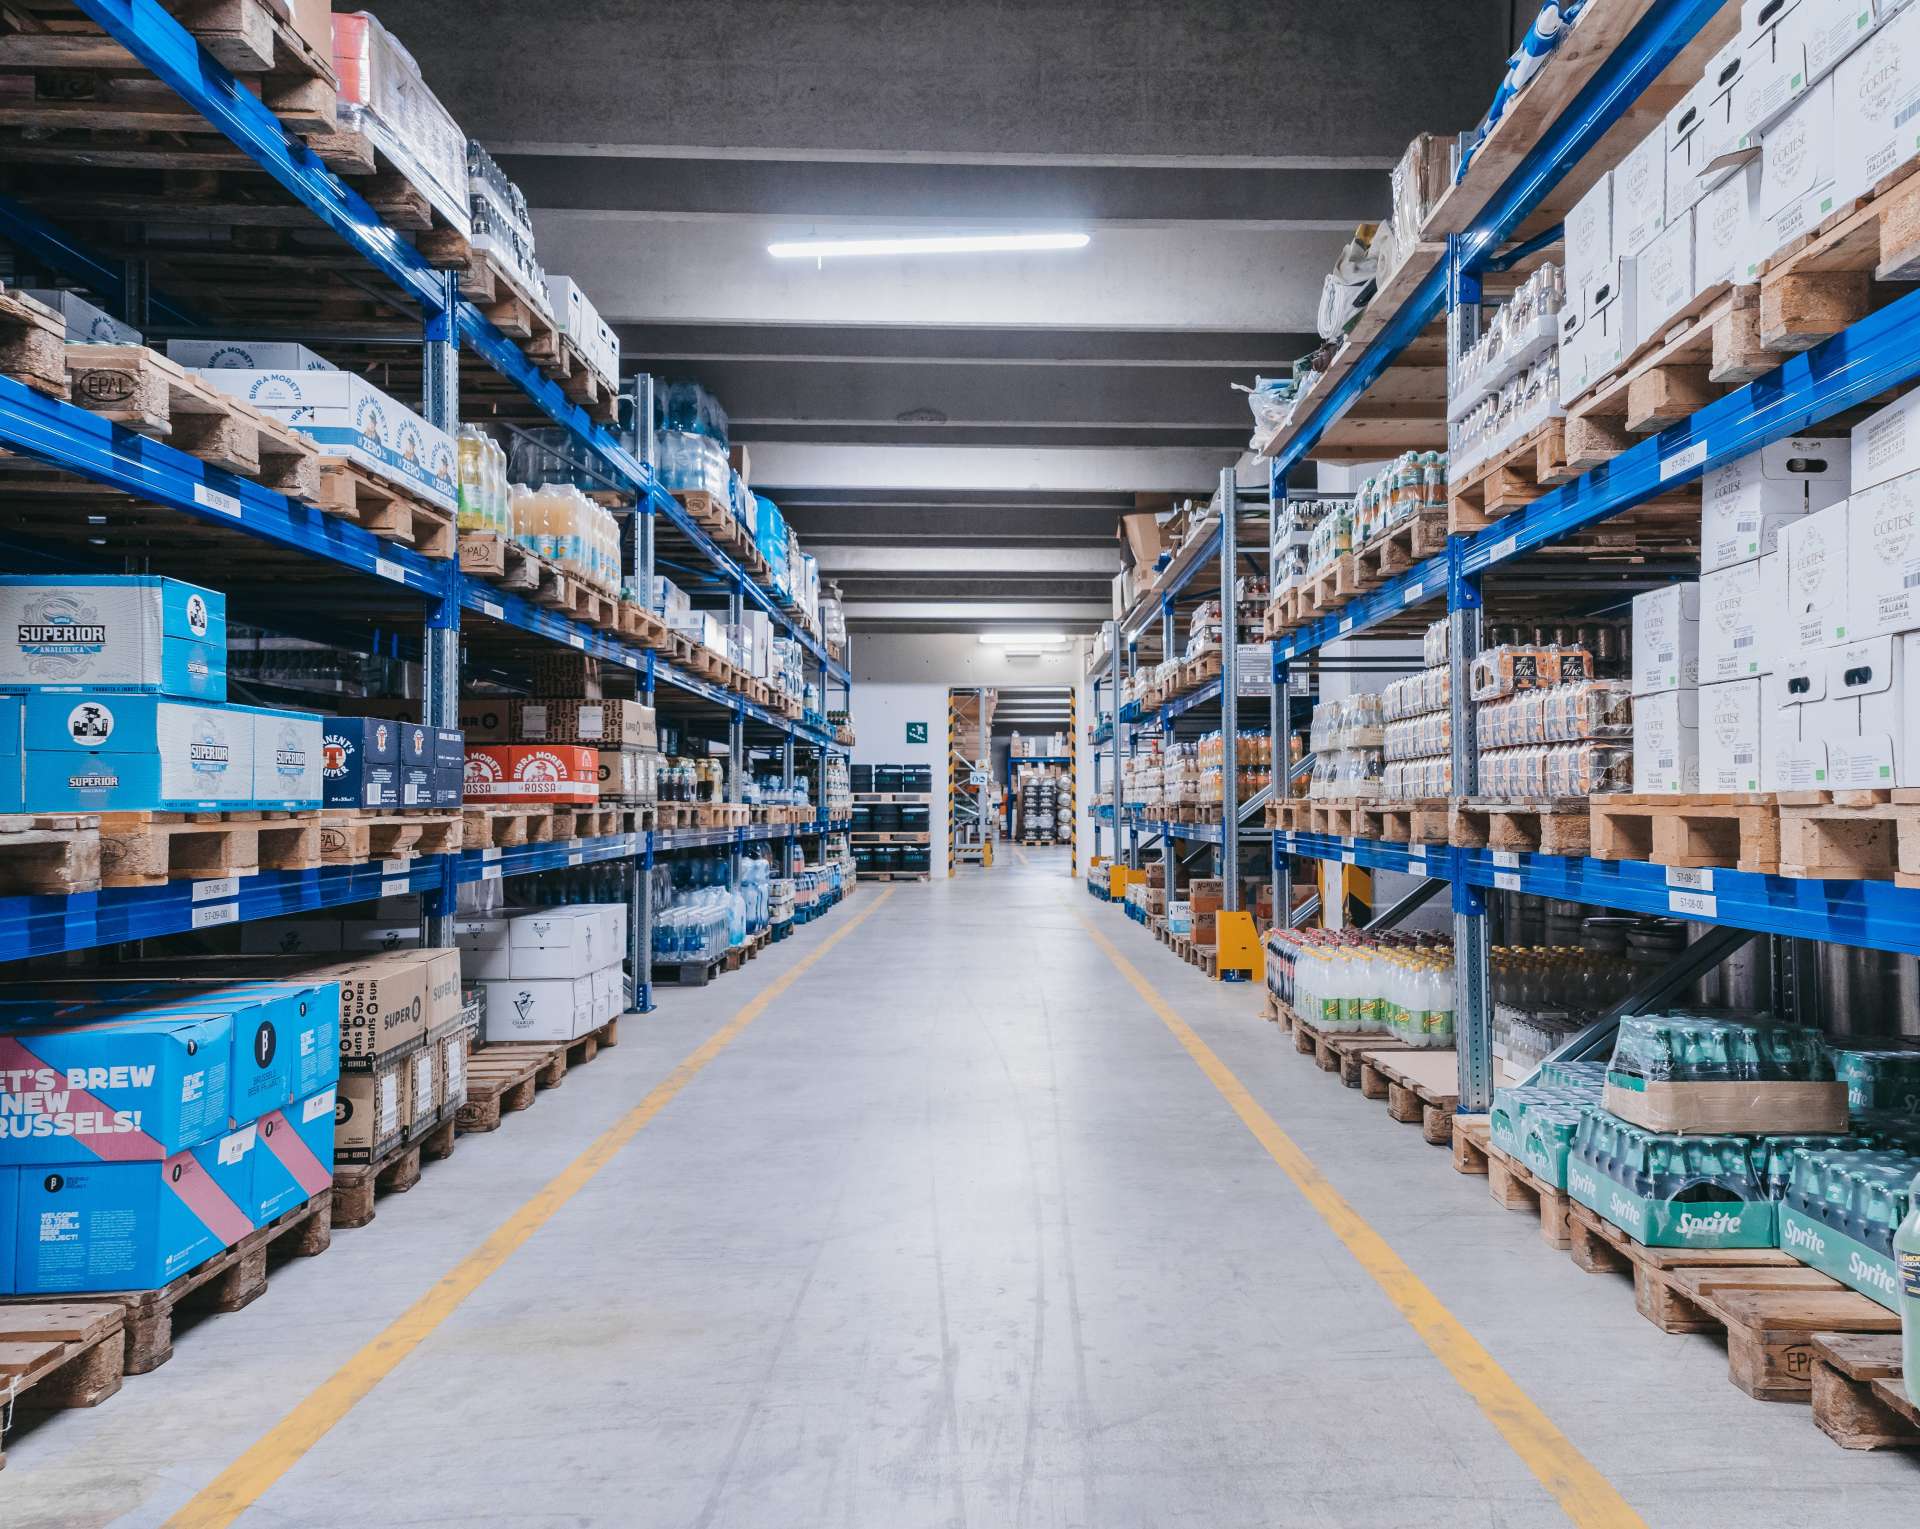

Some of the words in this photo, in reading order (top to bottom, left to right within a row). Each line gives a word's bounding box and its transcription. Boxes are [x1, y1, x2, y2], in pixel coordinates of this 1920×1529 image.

[1866, 149, 1897, 176] ITALIANA
[227, 347, 255, 369] MORETT
[88, 376, 128, 394] EPAL
[249, 375, 270, 400] BIRRA
[270, 374, 302, 400] MORETTI
[362, 437, 382, 458] ZERO
[402, 460, 421, 479] ZERO
[435, 479, 452, 497] ZERO
[1714, 479, 1741, 498] CORTESE
[1873, 511, 1915, 537] CORTESE
[1880, 600, 1909, 614] ITALIANA
[20, 626, 104, 642] SUPERIOR
[40, 645, 84, 653] ANALCOLICA
[191, 745, 229, 761] SUPERIOR
[276, 751, 306, 766] SUPERIOR
[323, 766, 350, 778] UPER
[471, 752, 503, 780] MORETTI
[513, 754, 535, 779] BIRRA
[536, 751, 568, 779] MORETTI
[69, 777, 118, 787] SUPERIOR
[524, 783, 556, 793] ROSSA
[321, 834, 337, 846] PAL
[369, 982, 377, 1001] SUP
[432, 982, 452, 1001] SUPER
[343, 1005, 352, 1037] SUPER
[384, 1006, 410, 1031] SUPER
[354, 1031, 362, 1056] SUPE
[367, 1017, 376, 1049] SUPER
[67, 1065, 156, 1090] BREW
[0, 1090, 70, 1116] NEW
[1848, 1087, 1867, 1107] rite
[1570, 1168, 1597, 1197] Sprite
[1610, 1192, 1640, 1225] Sprite
[1676, 1211, 1742, 1235] Sprite
[1784, 1218, 1826, 1256] Sprite
[1848, 1251, 1895, 1294] Sprite
